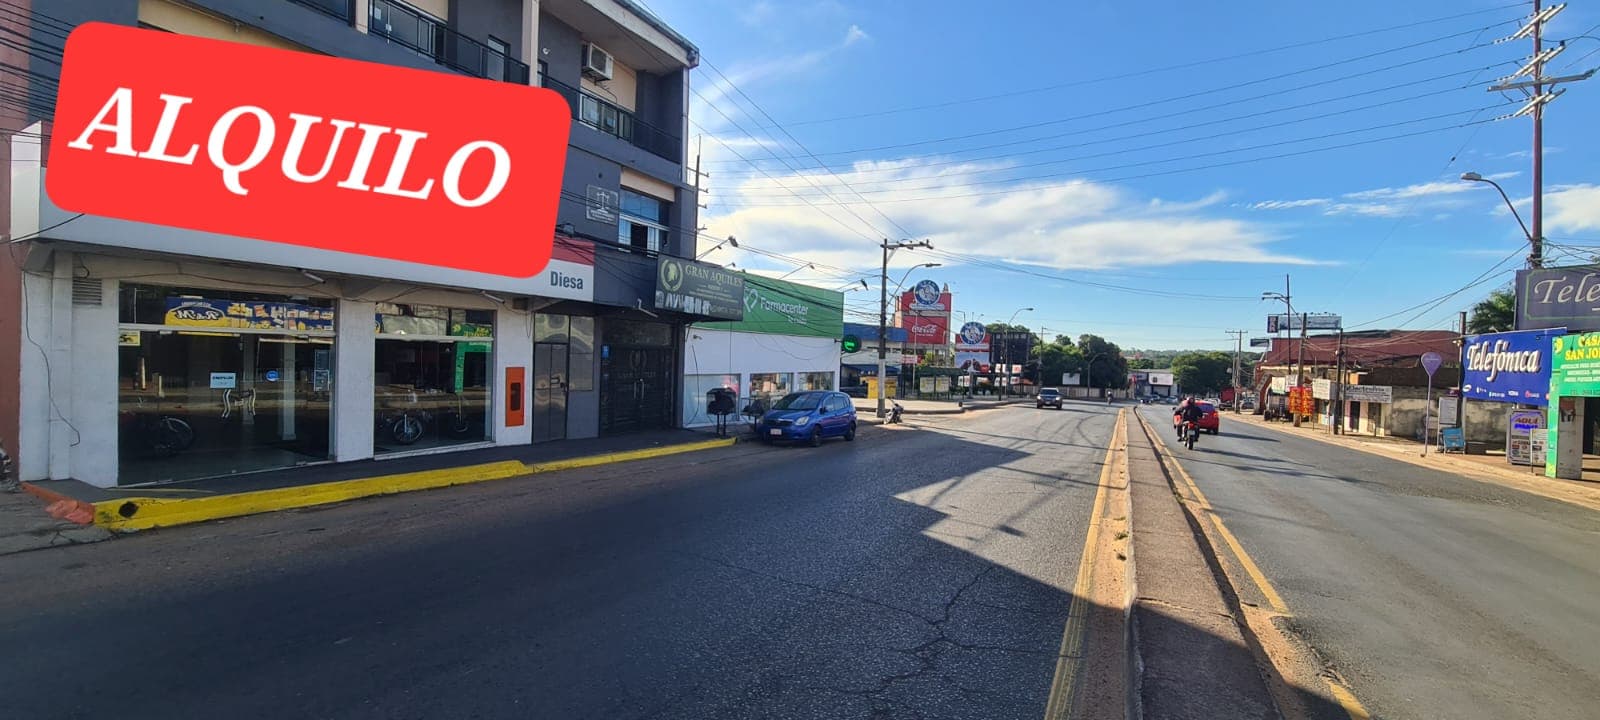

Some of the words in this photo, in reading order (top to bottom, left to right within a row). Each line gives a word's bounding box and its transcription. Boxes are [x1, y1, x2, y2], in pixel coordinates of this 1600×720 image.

[550, 271, 584, 290] Diesa
[685, 264, 709, 280] GRAN
[710, 272, 742, 287] AQUILES
[760, 297, 809, 315] Farmacenter
[1565, 349, 1584, 361] SAN
[1586, 347, 1600, 359] JO
